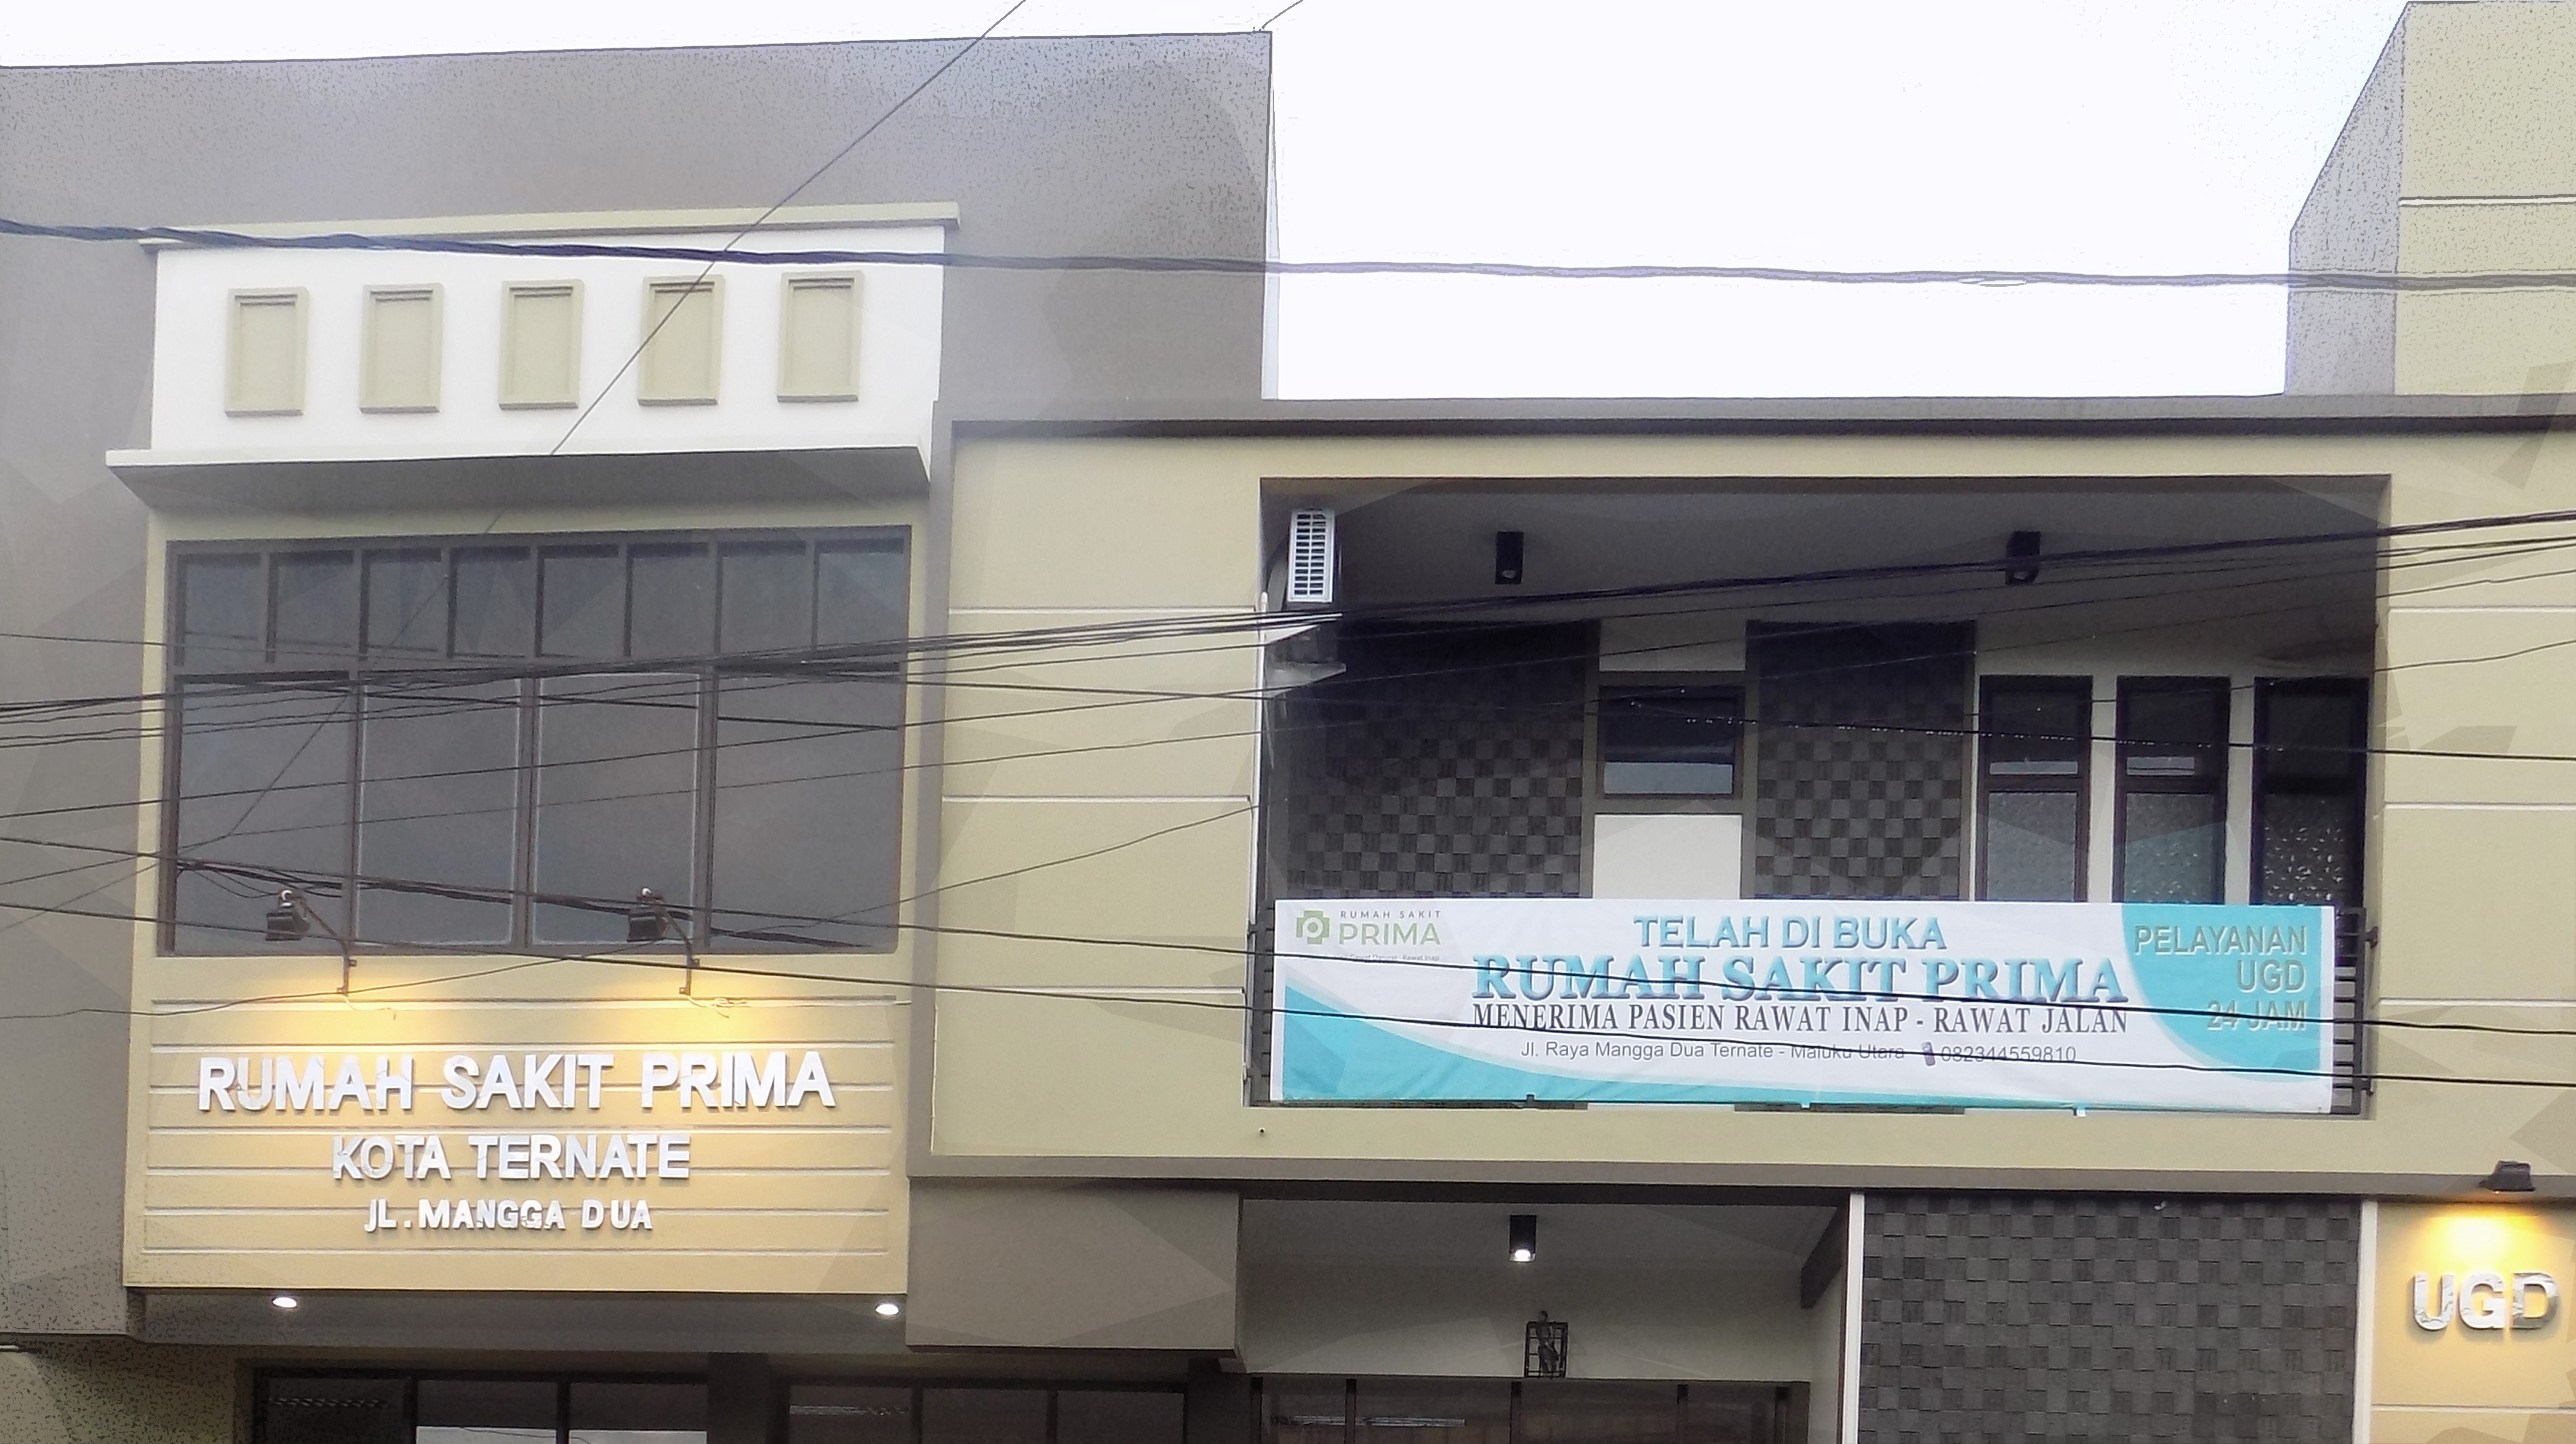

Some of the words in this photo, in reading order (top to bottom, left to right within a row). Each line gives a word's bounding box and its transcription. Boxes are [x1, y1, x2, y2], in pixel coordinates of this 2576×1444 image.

[1340, 910, 1390, 918] RUMAH
[1400, 910, 1440, 918] SAKIT
[1340, 923, 1440, 945] PRIMA
[1634, 915, 1769, 948] TELAH
[1782, 916, 1821, 948] DI
[1834, 916, 1948, 950] BUKA
[2134, 925, 2308, 955] PELAYANAN
[1472, 954, 1706, 1000] RUMAH
[1722, 956, 1906, 1002] SAKIT
[1922, 958, 2130, 1004] PRIMA
[2236, 960, 2306, 993] UGD
[1472, 1003, 1619, 1030] MENERIMA
[1628, 1004, 1726, 1031] PASIEN
[1736, 1006, 1831, 1032] RAWAT
[1842, 1006, 1908, 1032] INAP
[1934, 1007, 2032, 1034] RAWAT
[2042, 1007, 2128, 1034] JALAN
[2207, 1000, 2238, 1030] 24
[2247, 1000, 2308, 1031] JAM
[1546, 1042, 1590, 1060] Raya
[1596, 1042, 1664, 1060] Mangga
[1672, 1042, 1704, 1058] Dua
[1710, 1042, 1774, 1058] Ternate
[1792, 1045, 1852, 1059] Maluku
[1858, 1044, 1905, 1060] Utara
[1941, 1046, 2077, 1063] 082344559810
[198, 1056, 414, 1112] RUMAH
[441, 1054, 615, 1110] SAKIT
[641, 1051, 836, 1108] PRIMA
[333, 1136, 452, 1180] KOTA
[469, 1134, 691, 1180] TERNATE
[581, 1199, 653, 1230] DUA
[2412, 1272, 2558, 1330] UGD
